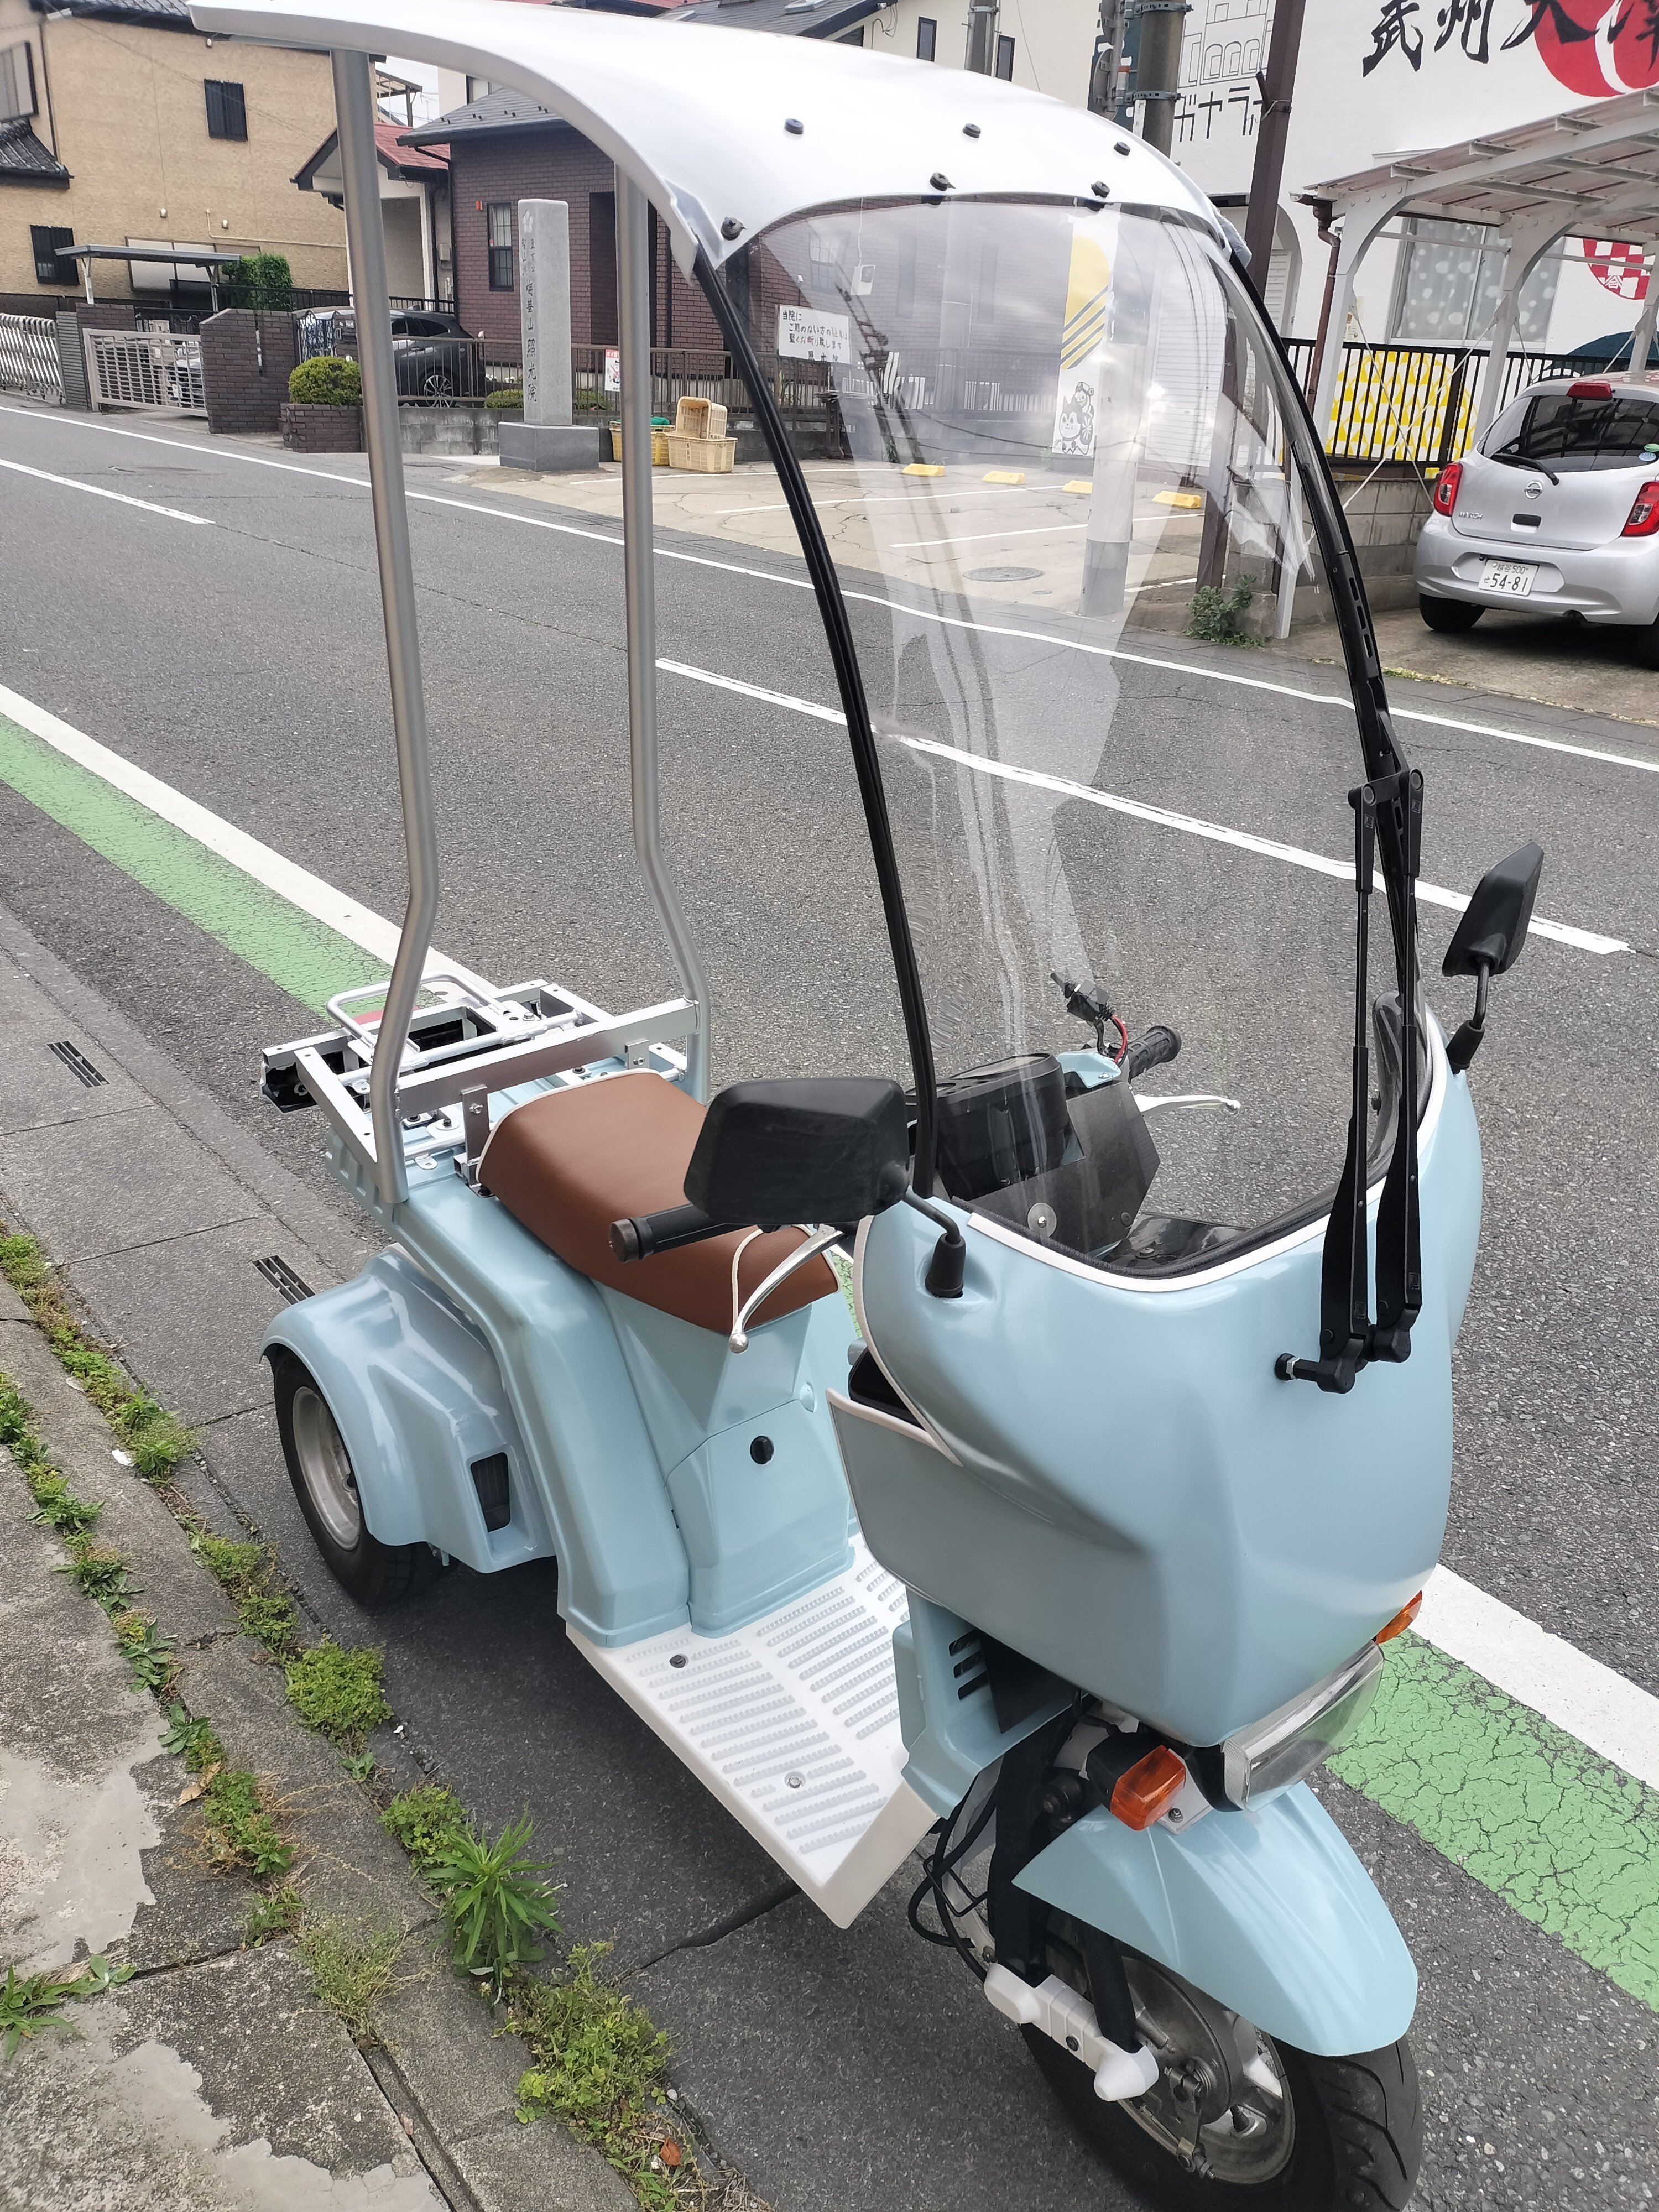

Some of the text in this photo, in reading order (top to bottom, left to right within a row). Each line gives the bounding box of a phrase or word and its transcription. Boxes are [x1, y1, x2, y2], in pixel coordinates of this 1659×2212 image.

[782, 310, 802, 321] 当院に
[1490, 573, 1528, 593] 54-81
